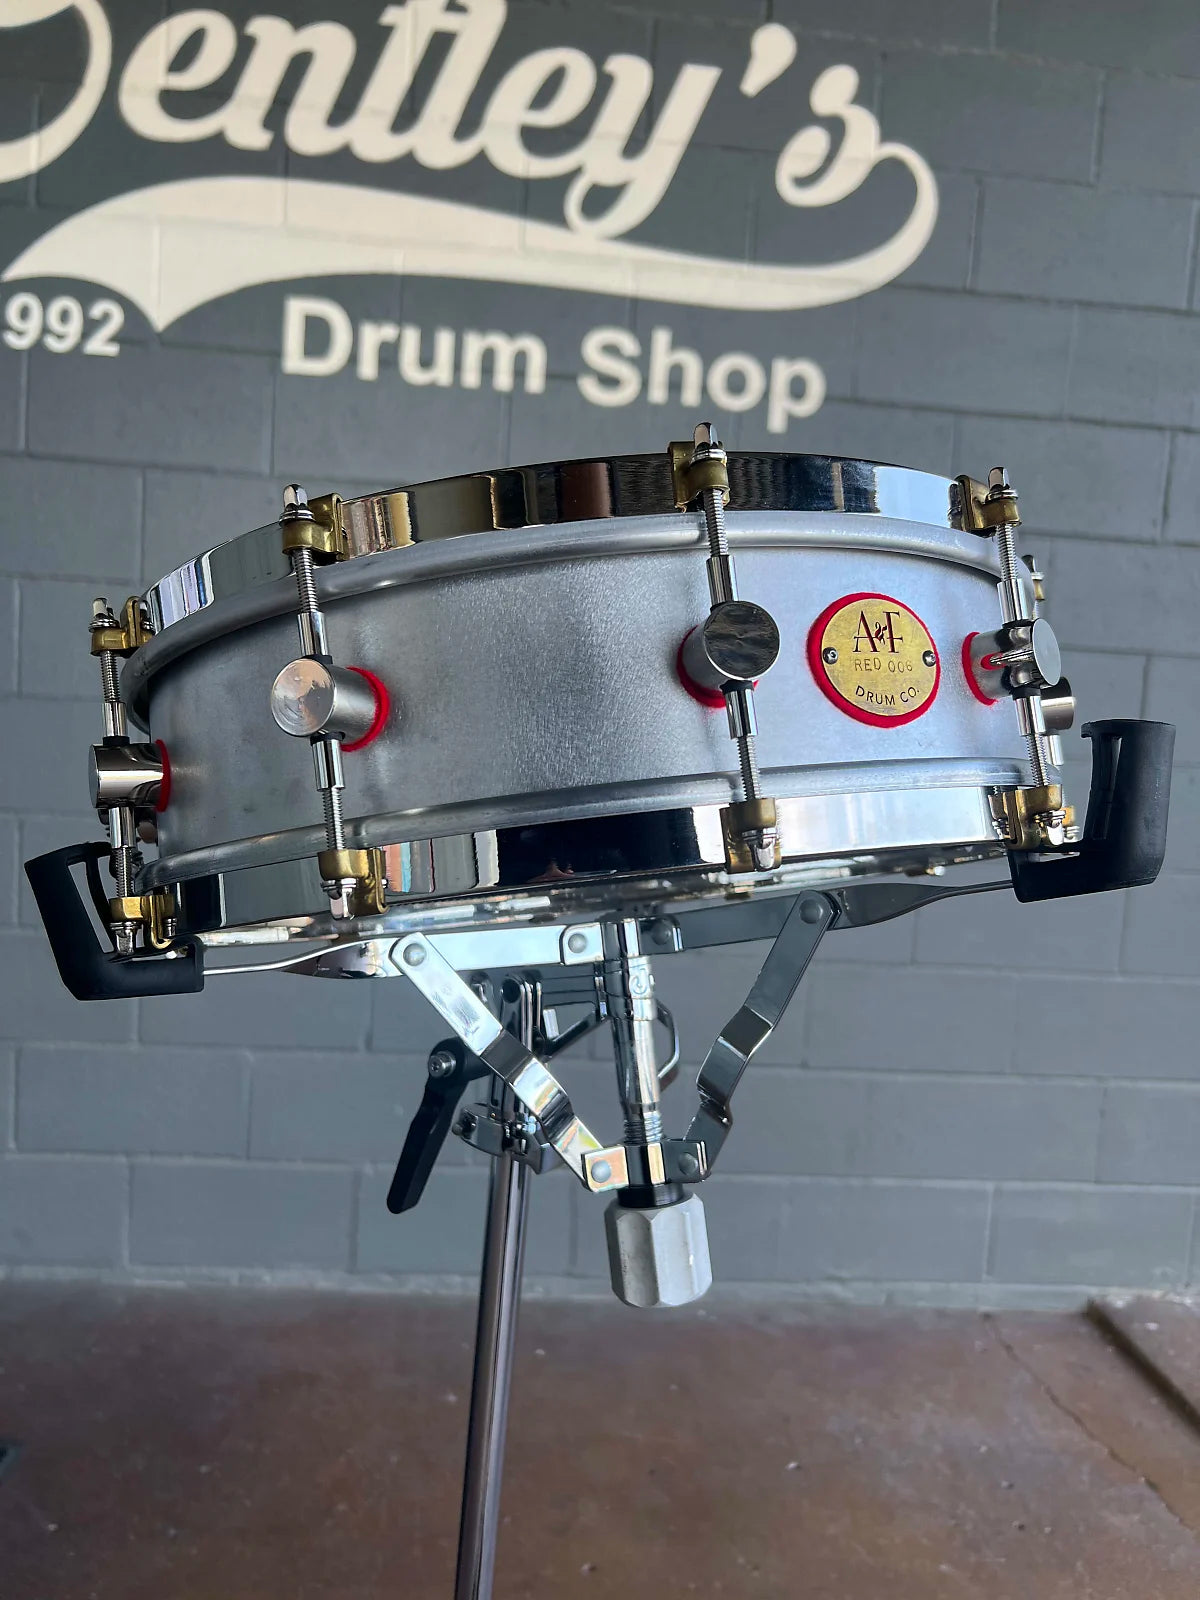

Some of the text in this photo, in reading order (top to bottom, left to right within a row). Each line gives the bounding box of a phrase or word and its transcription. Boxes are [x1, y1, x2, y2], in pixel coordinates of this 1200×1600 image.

[281, 295, 827, 434] Drum Shop
[852, 610, 904, 654] A&F
[853, 657, 913, 673] RED 006
[855, 685, 920, 706] DRUM CO.
